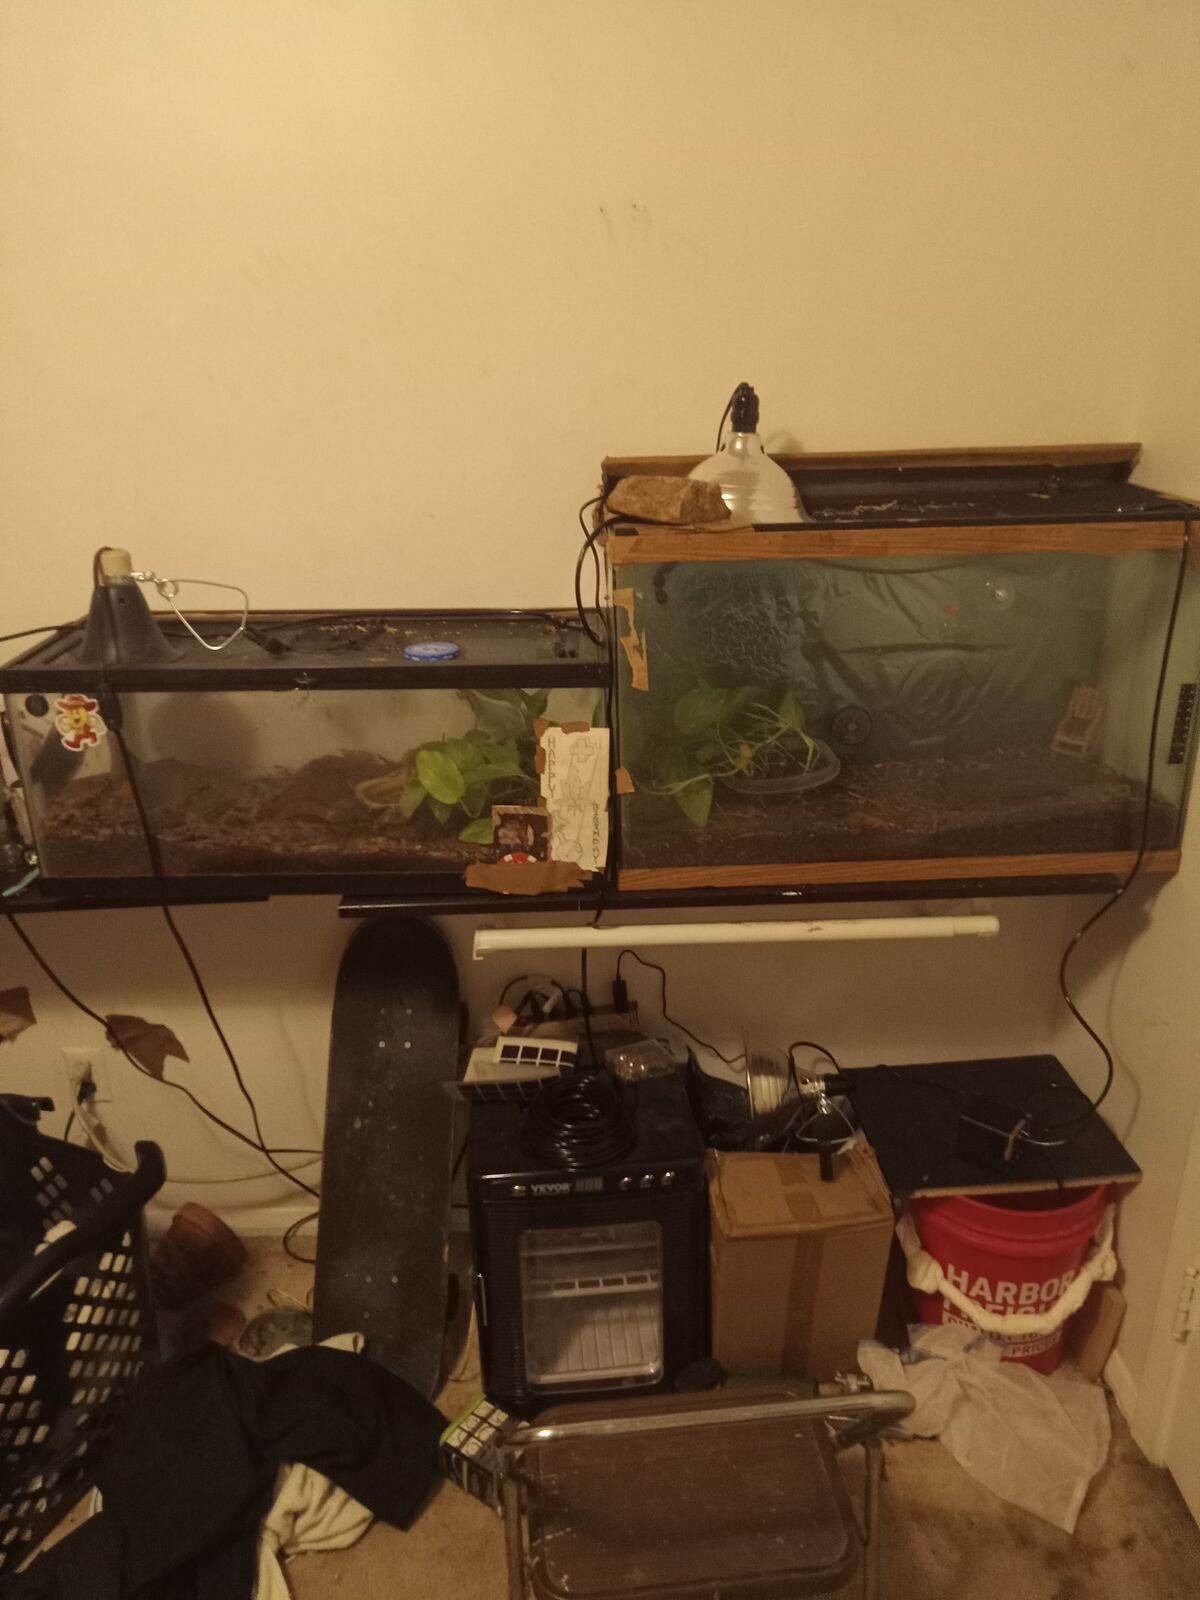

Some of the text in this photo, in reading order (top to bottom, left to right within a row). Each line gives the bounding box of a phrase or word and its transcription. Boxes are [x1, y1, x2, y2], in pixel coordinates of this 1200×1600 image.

[547, 736, 556, 799] HAPPY
[530, 1182, 570, 1193] VEVOR
[946, 1263, 1075, 1305] HARBOR
